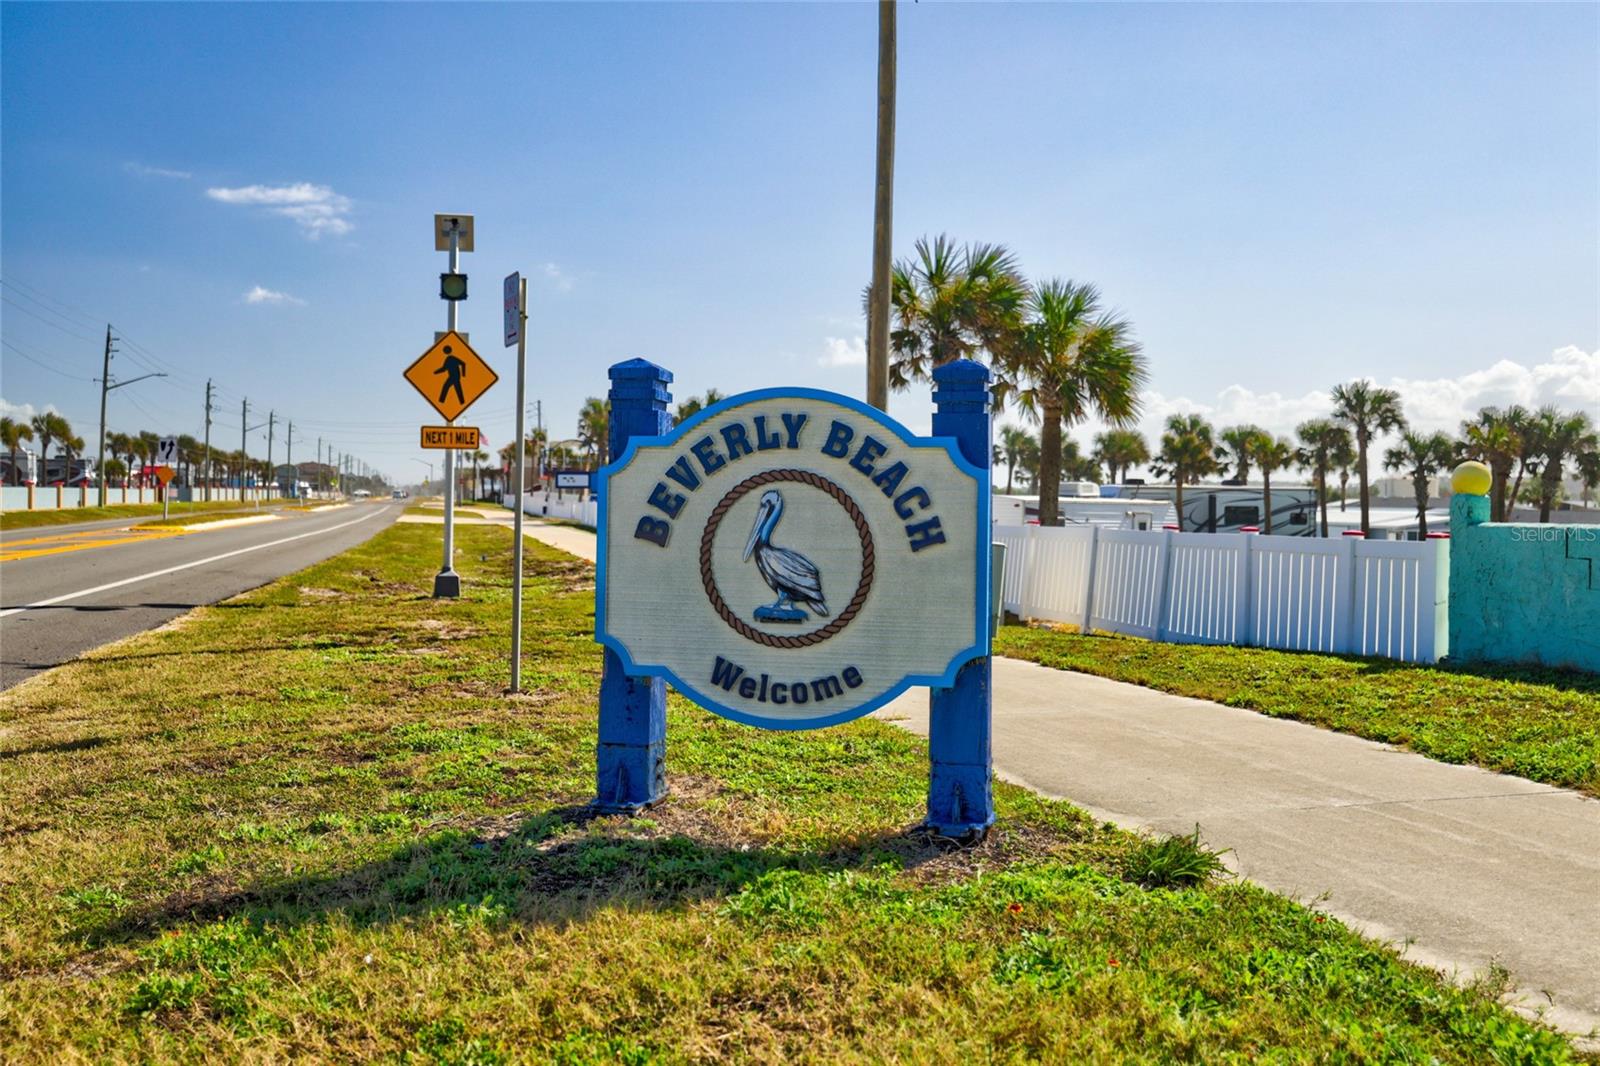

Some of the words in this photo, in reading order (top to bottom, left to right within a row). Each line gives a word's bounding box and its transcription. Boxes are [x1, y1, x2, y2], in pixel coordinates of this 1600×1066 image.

[425, 431, 447, 444] NEXT
[456, 432, 475, 445] MILE
[634, 413, 807, 547] BEVERLY
[821, 420, 947, 552] BEACH
[709, 655, 863, 704] Welcome
